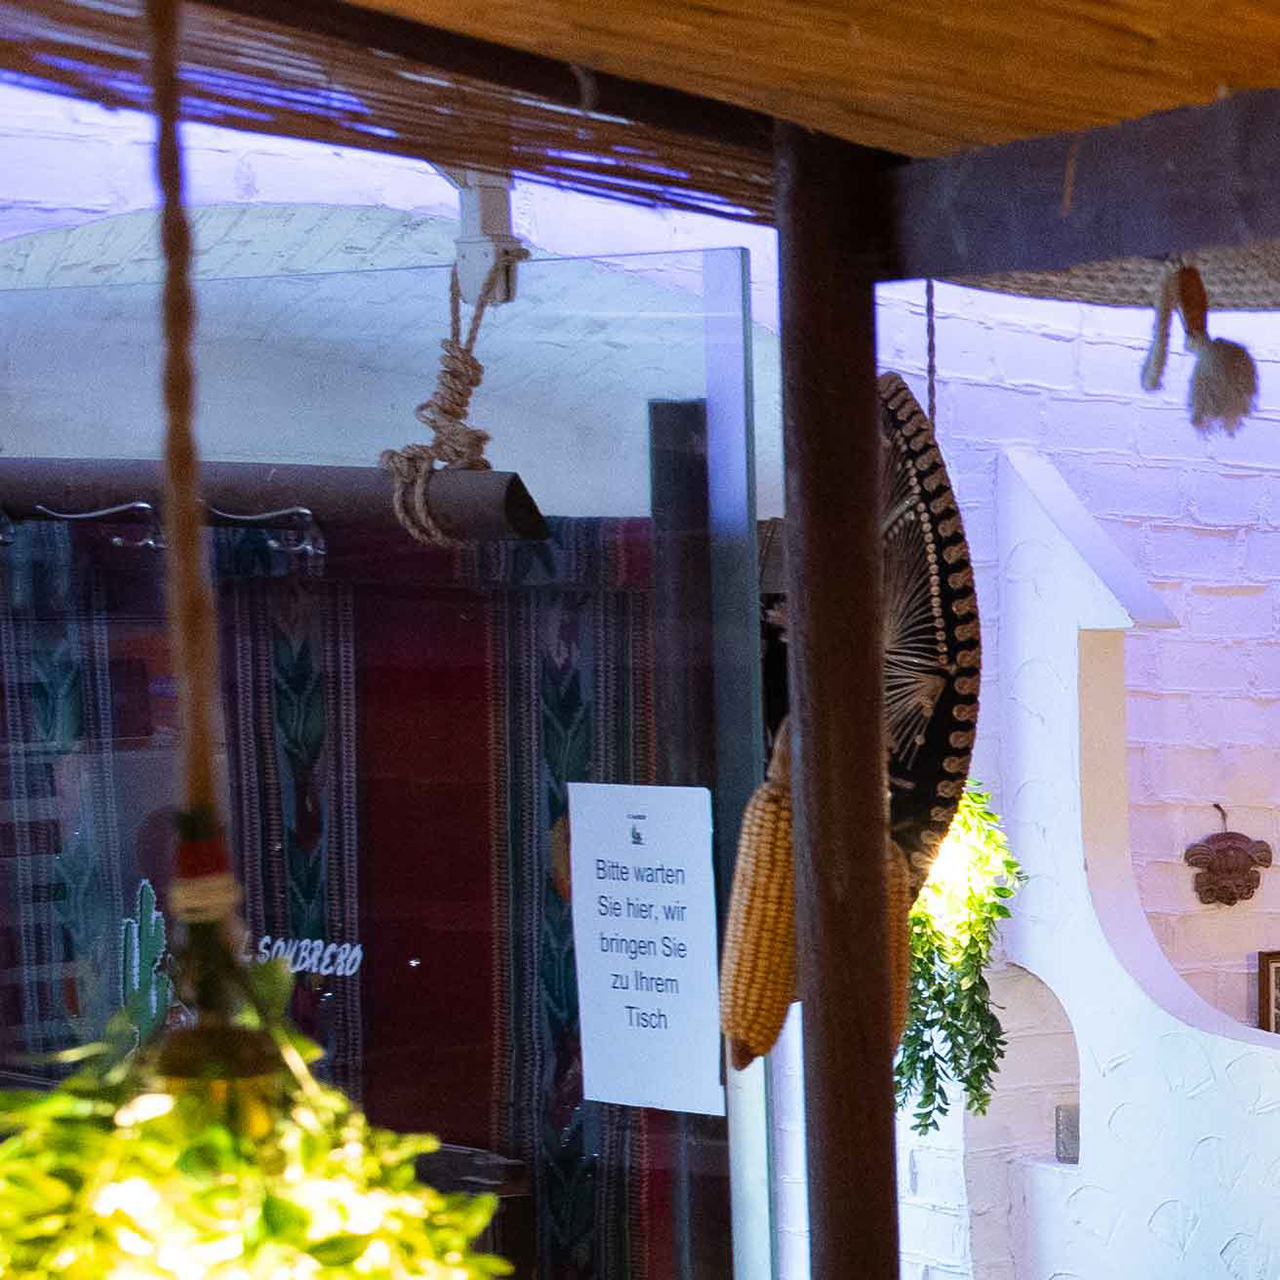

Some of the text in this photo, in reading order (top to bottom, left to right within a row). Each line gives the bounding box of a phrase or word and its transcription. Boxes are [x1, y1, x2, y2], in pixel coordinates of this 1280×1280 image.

[595, 859, 686, 885] Bitte warten
[598, 895, 688, 922] Sie hier, wir
[600, 932, 687, 960] bringen Sie
[610, 970, 680, 994] zu Ihrem
[624, 1005, 669, 1029] Tisch
